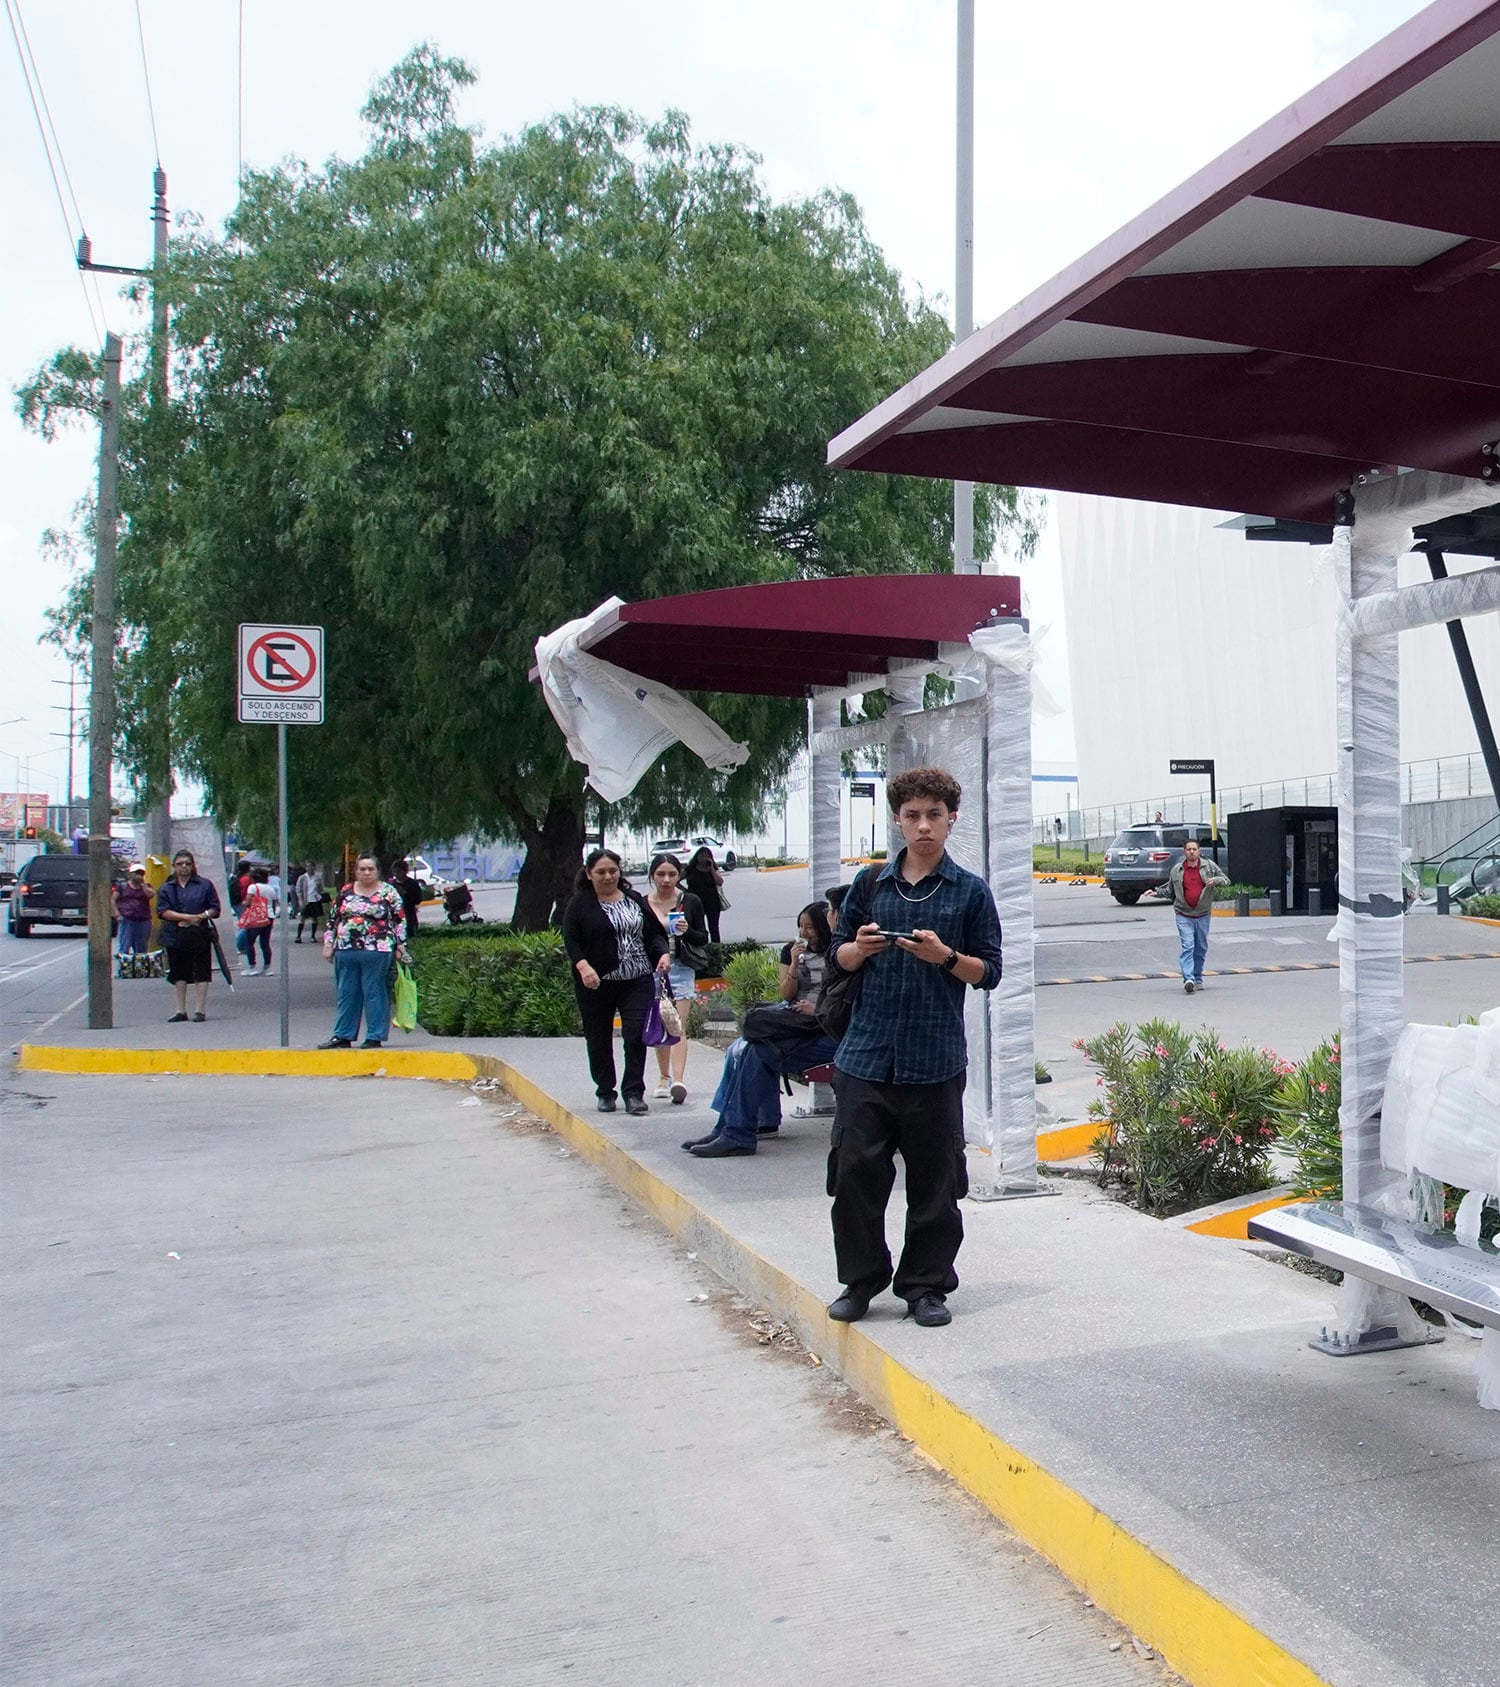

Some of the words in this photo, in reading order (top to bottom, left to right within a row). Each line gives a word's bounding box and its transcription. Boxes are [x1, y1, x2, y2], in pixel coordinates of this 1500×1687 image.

[247, 701, 272, 710] SOLO
[273, 702, 315, 710] ASCENSO
[262, 711, 309, 719] DESCENSO
[422, 853, 524, 881] EBLA
